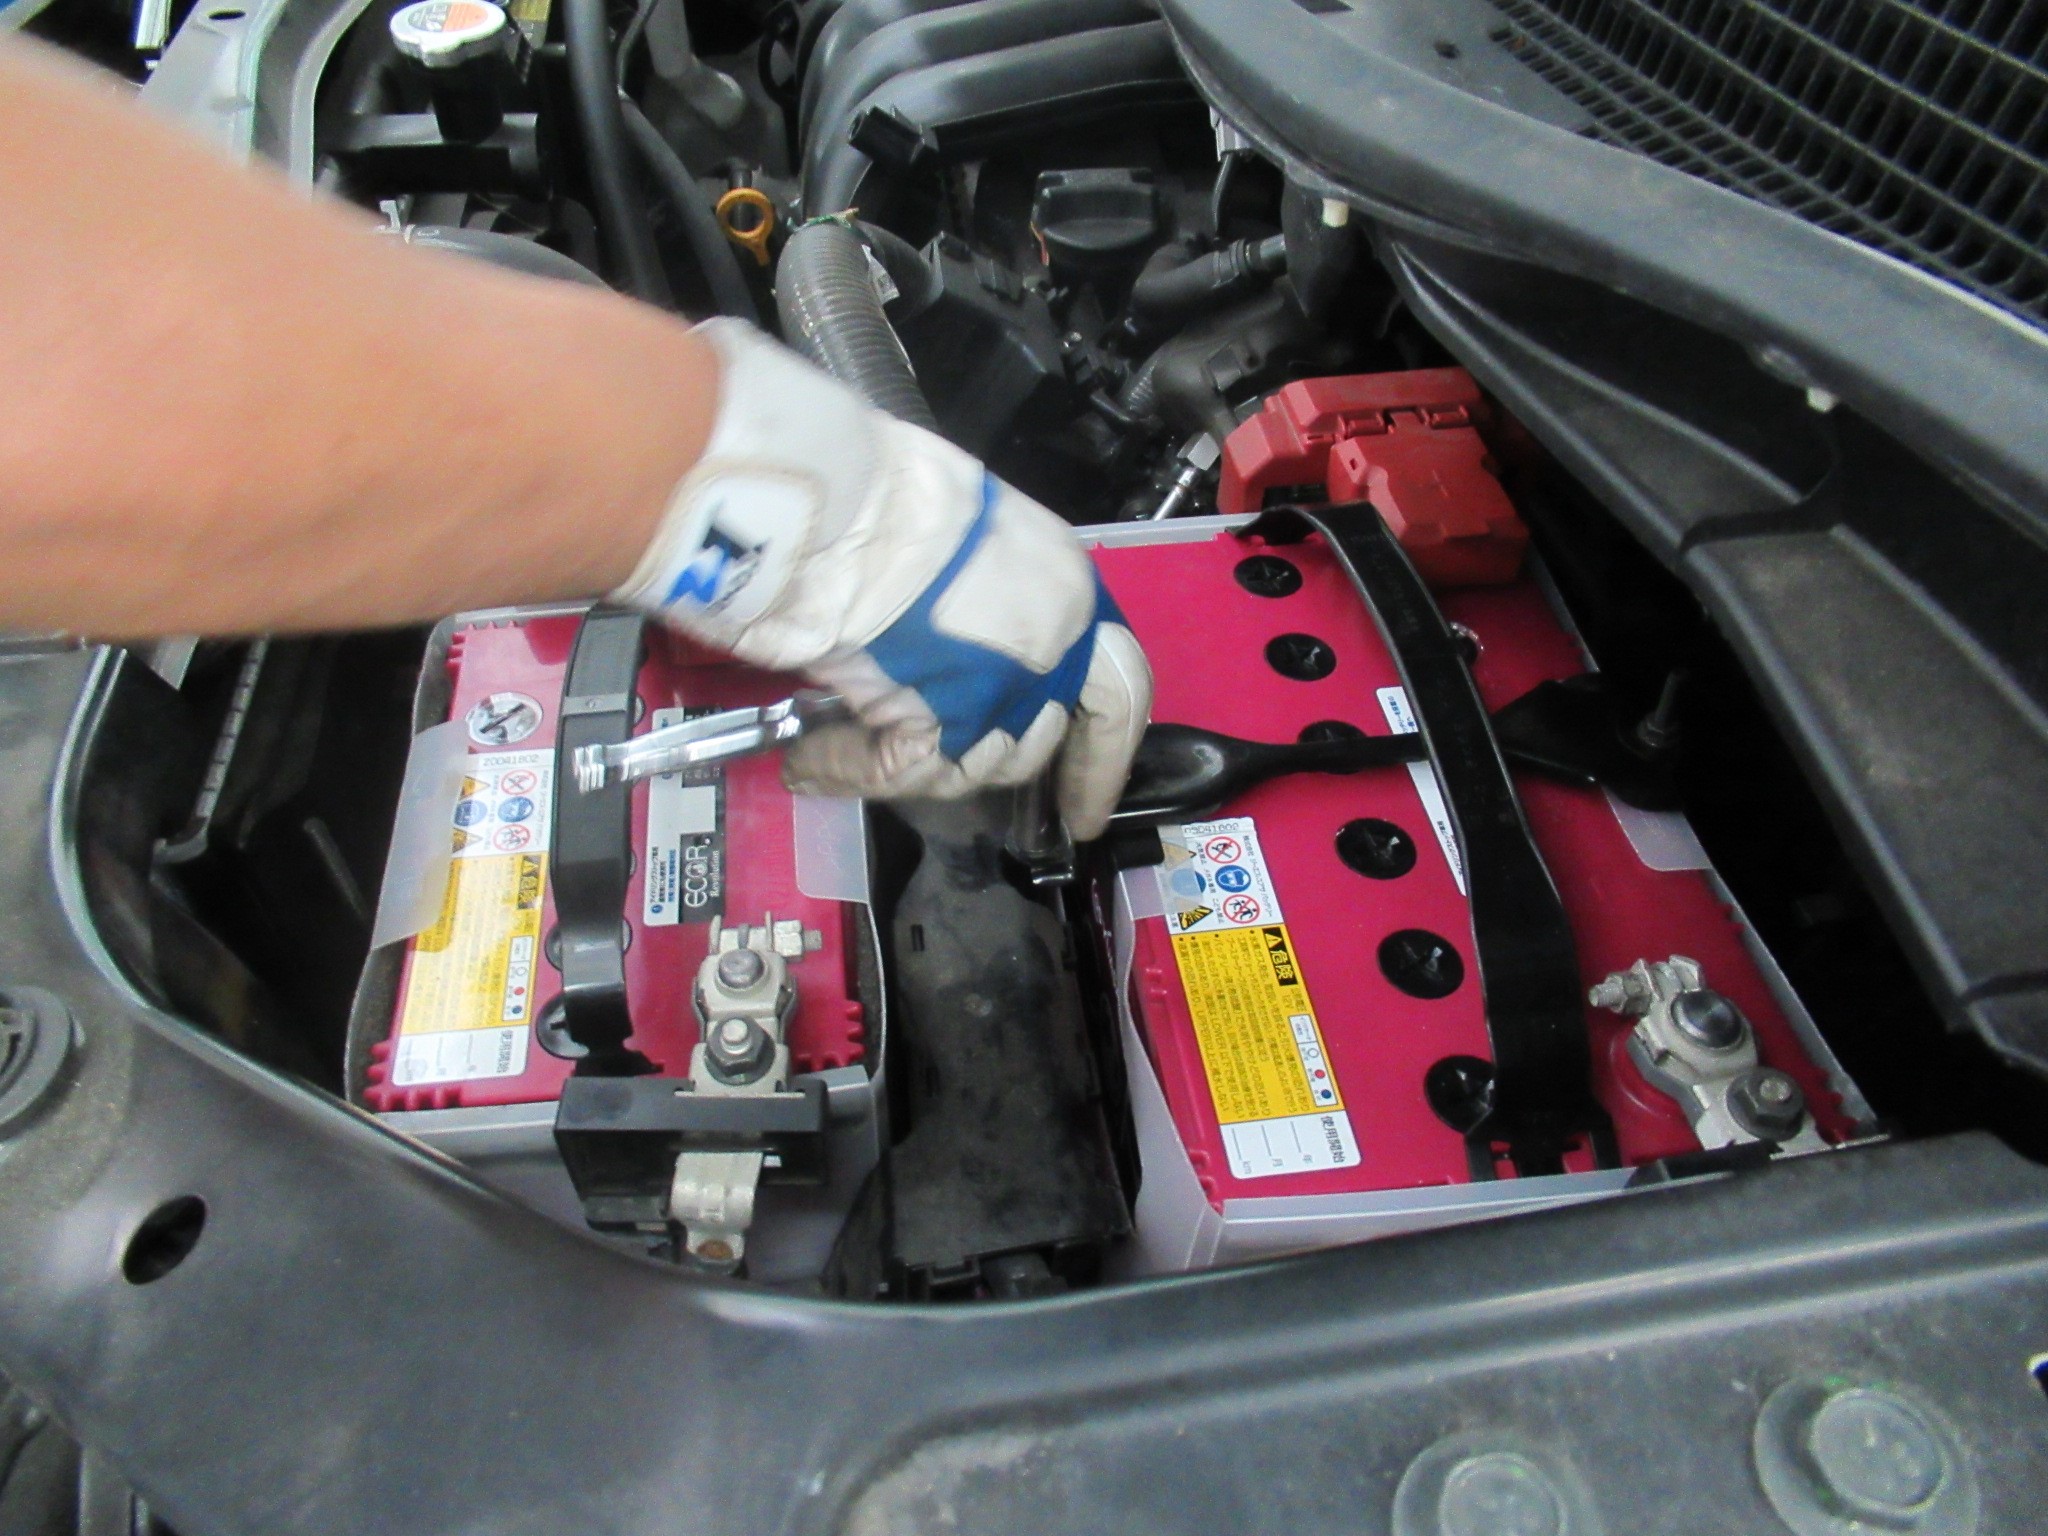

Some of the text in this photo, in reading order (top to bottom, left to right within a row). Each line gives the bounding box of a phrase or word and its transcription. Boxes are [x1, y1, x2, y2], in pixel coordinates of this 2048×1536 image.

[1269, 949, 1294, 979] 危険
[1320, 1115, 1345, 1163] 使用開始
[1241, 1160, 1252, 1174] km
